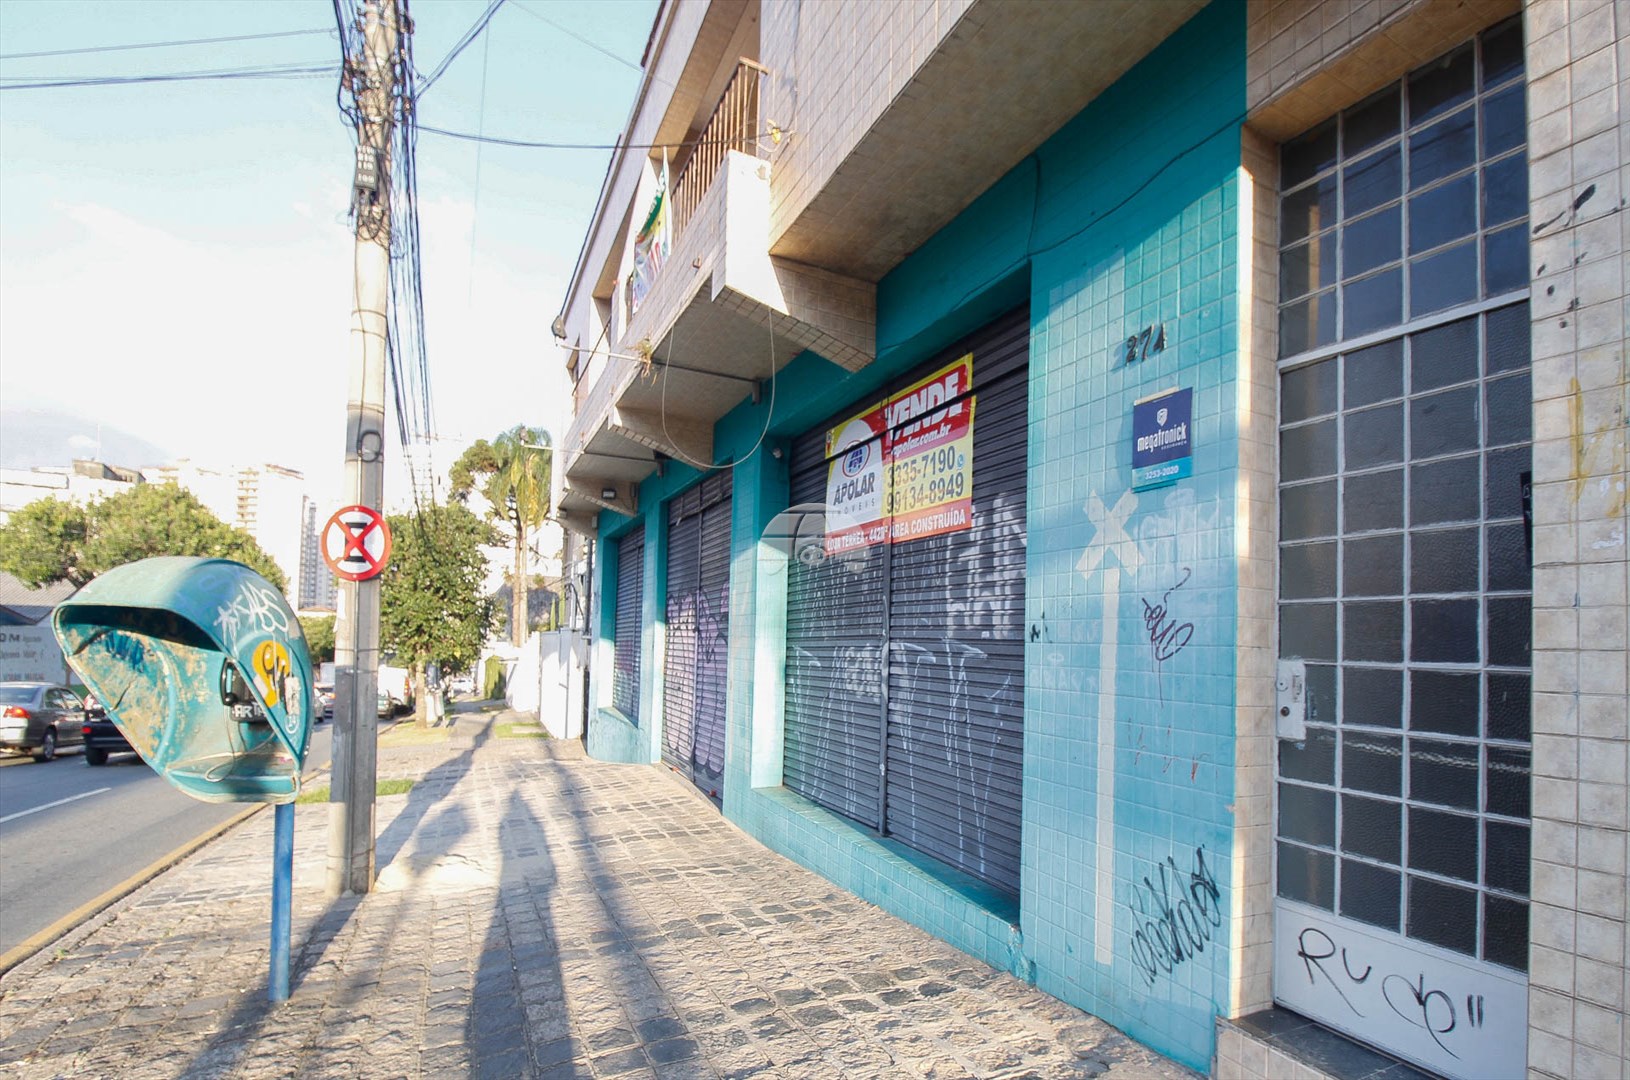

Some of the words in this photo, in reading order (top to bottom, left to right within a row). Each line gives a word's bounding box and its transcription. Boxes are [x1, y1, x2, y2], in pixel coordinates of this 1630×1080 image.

[1126, 323, 1166, 366] 274
[885, 372, 963, 440] VENDE
[1137, 421, 1187, 453] megatronick
[887, 445, 955, 488] 3335-7190
[833, 472, 876, 506] APOLAR
[886, 471, 965, 514] 99134-8949
[911, 508, 966, 534] CONSTRUÍDA
